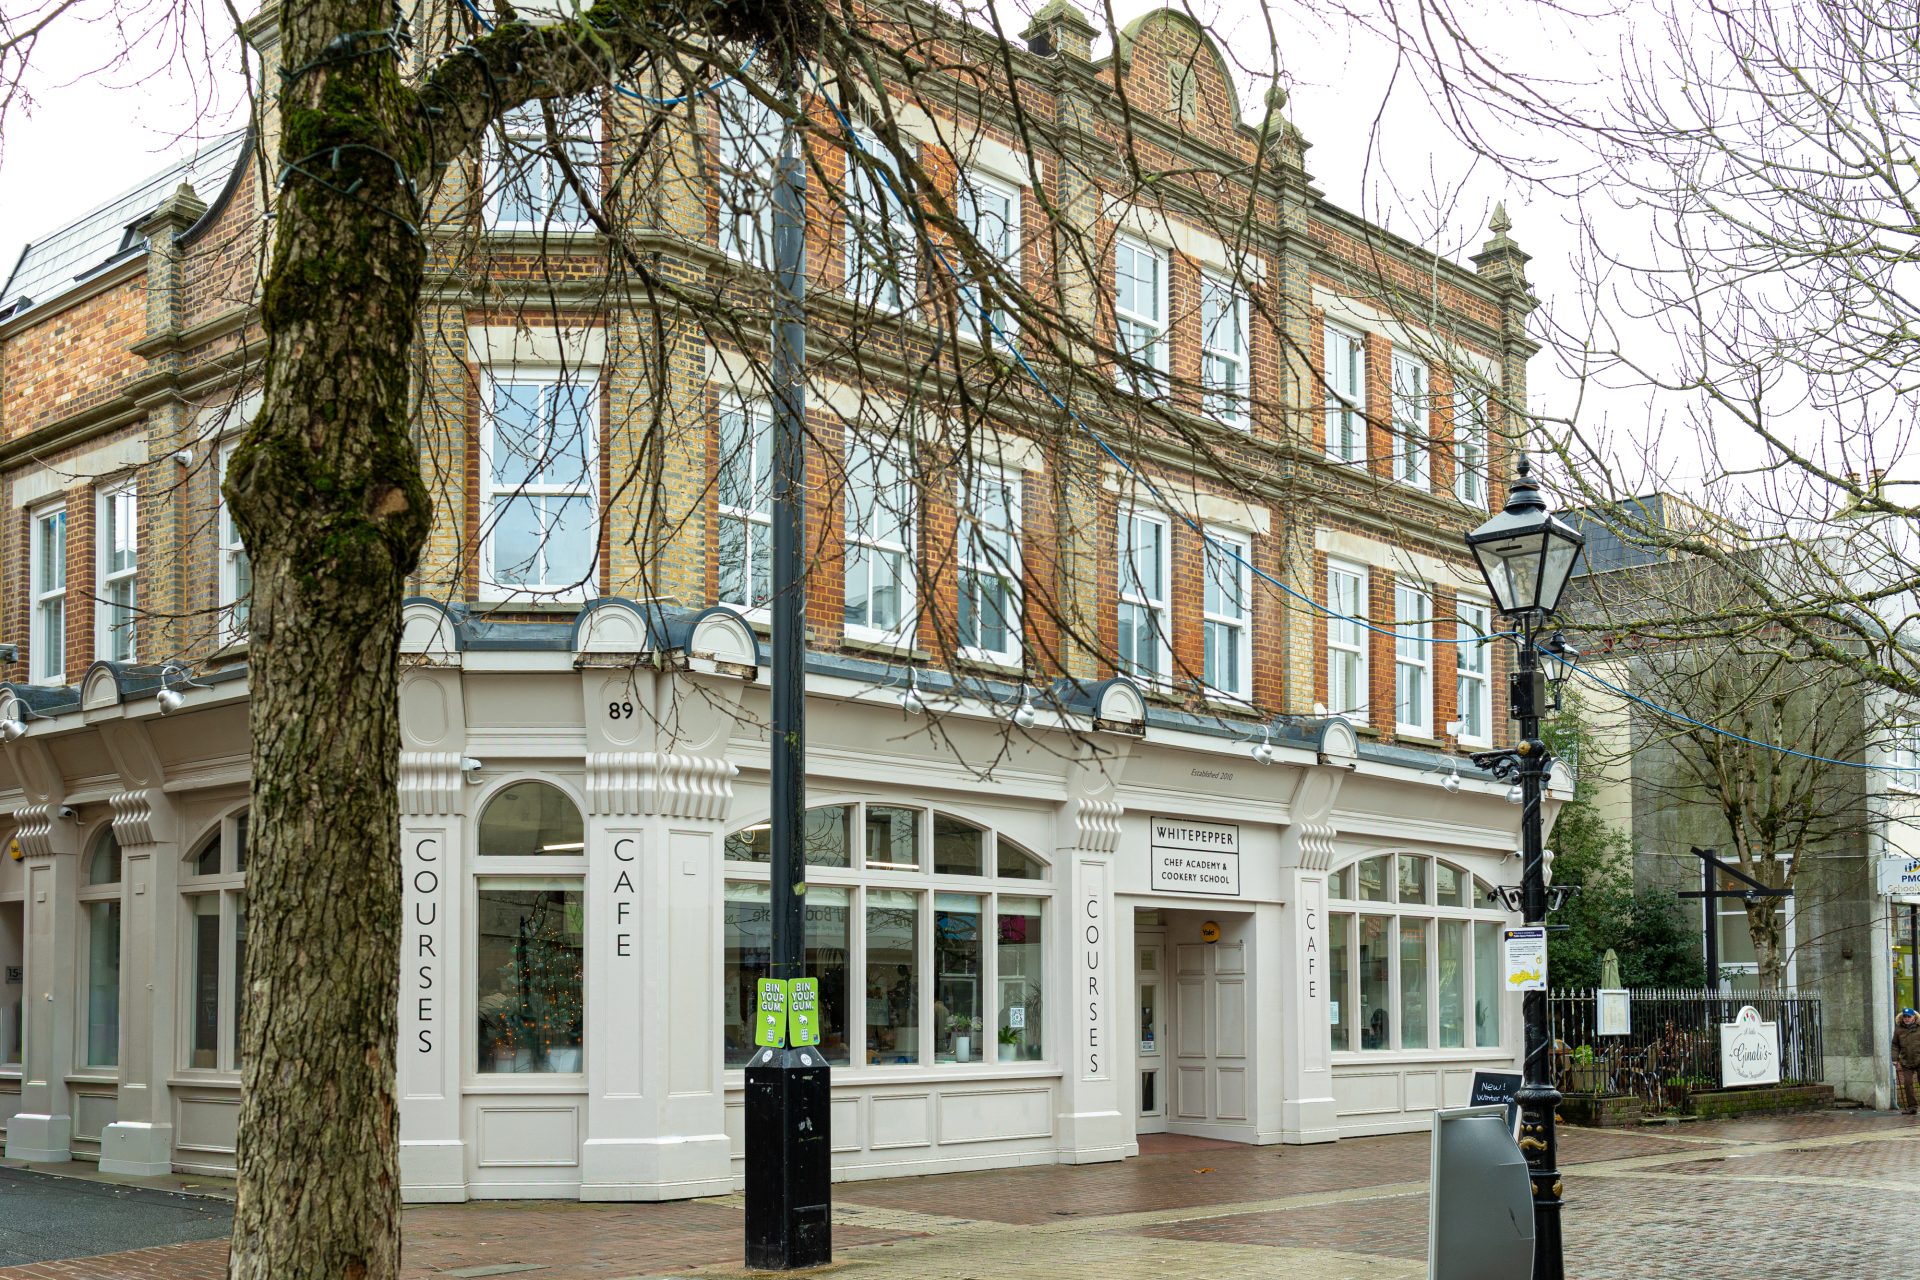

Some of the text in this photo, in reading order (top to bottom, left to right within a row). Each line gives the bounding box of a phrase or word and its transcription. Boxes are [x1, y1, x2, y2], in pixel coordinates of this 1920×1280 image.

[609, 701, 633, 719] 89
[1157, 826, 1233, 845] WHITEPEPPER
[1164, 858, 1227, 871] CHEF ACADEMY &
[1161, 872, 1230, 884] COOKERY SCHOOL
[614, 838, 635, 957] CAFE
[414, 838, 438, 1053] COURSES
[1306, 913, 1316, 998] CAFE
[765, 983, 780, 993] BIN
[796, 982, 810, 992] BIN
[1086, 900, 1099, 1073] COURSES
[761, 992, 784, 1003] YOUR
[792, 991, 815, 1001] YOUR
[761, 1001, 783, 1012] GUM.
[792, 1001, 814, 1011] GUM.
[1476, 1094, 1500, 1102] Winter
